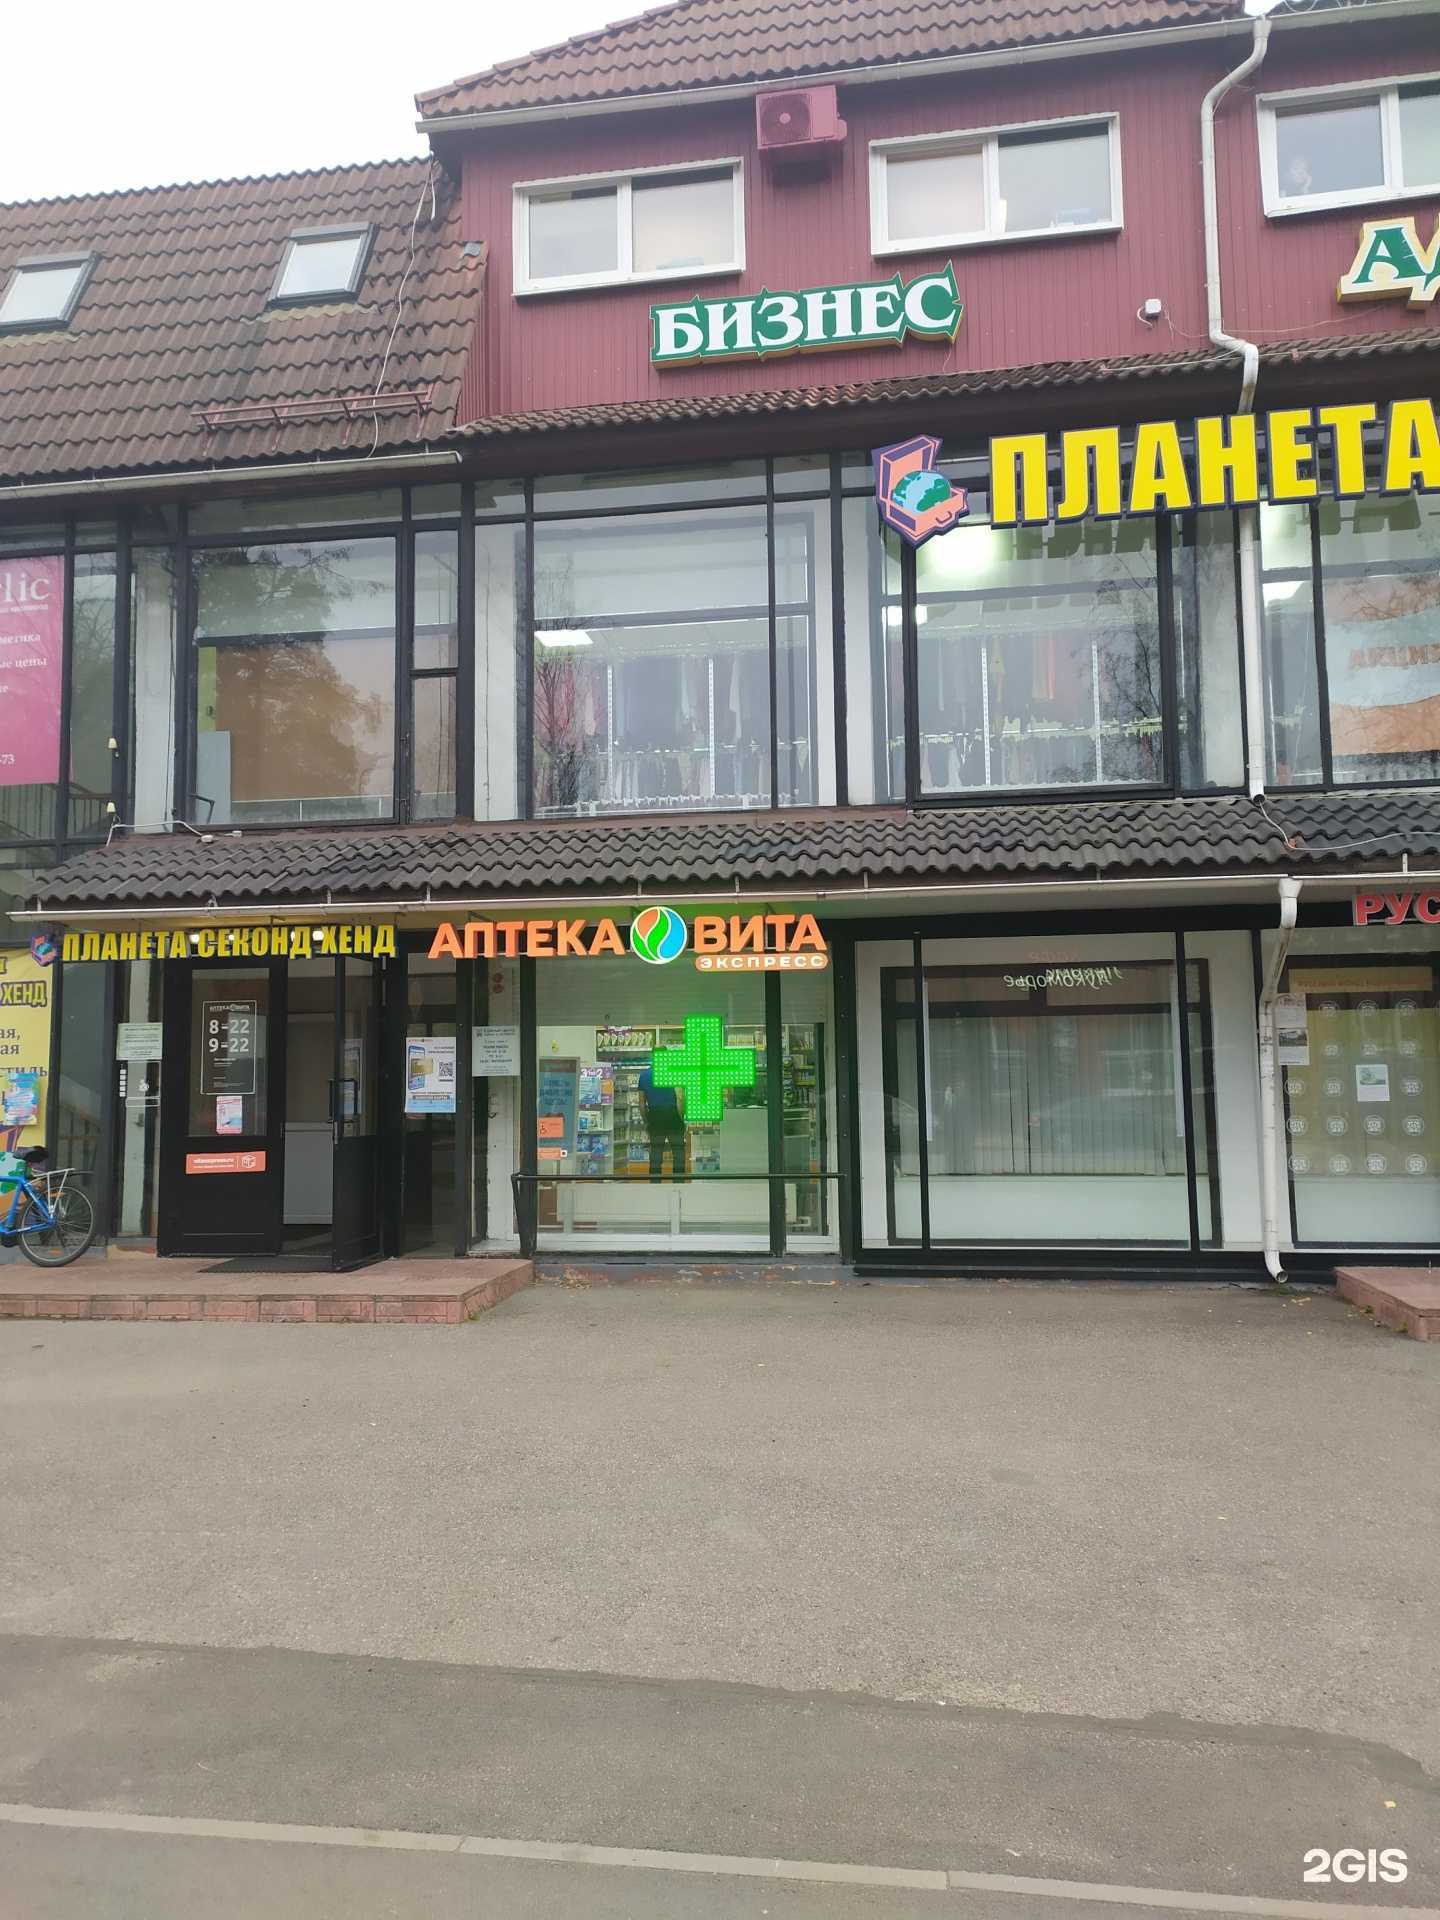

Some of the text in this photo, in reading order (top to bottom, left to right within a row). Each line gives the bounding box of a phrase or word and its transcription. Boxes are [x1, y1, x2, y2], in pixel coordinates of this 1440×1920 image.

[1346, 218, 1440, 296] А
[655, 276, 957, 356] БИЗНЕС
[990, 398, 1440, 526] ПЛАНЕТА
[0, 572, 50, 602] lic
[62, 924, 397, 962] ПЛАНЕТА СЕКОНД ХЕНД
[427, 914, 829, 960] АПТЕКА ВИТА
[698, 954, 827, 970] ЭКСПРЕСС
[1, 981, 47, 1007] ХЕНД
